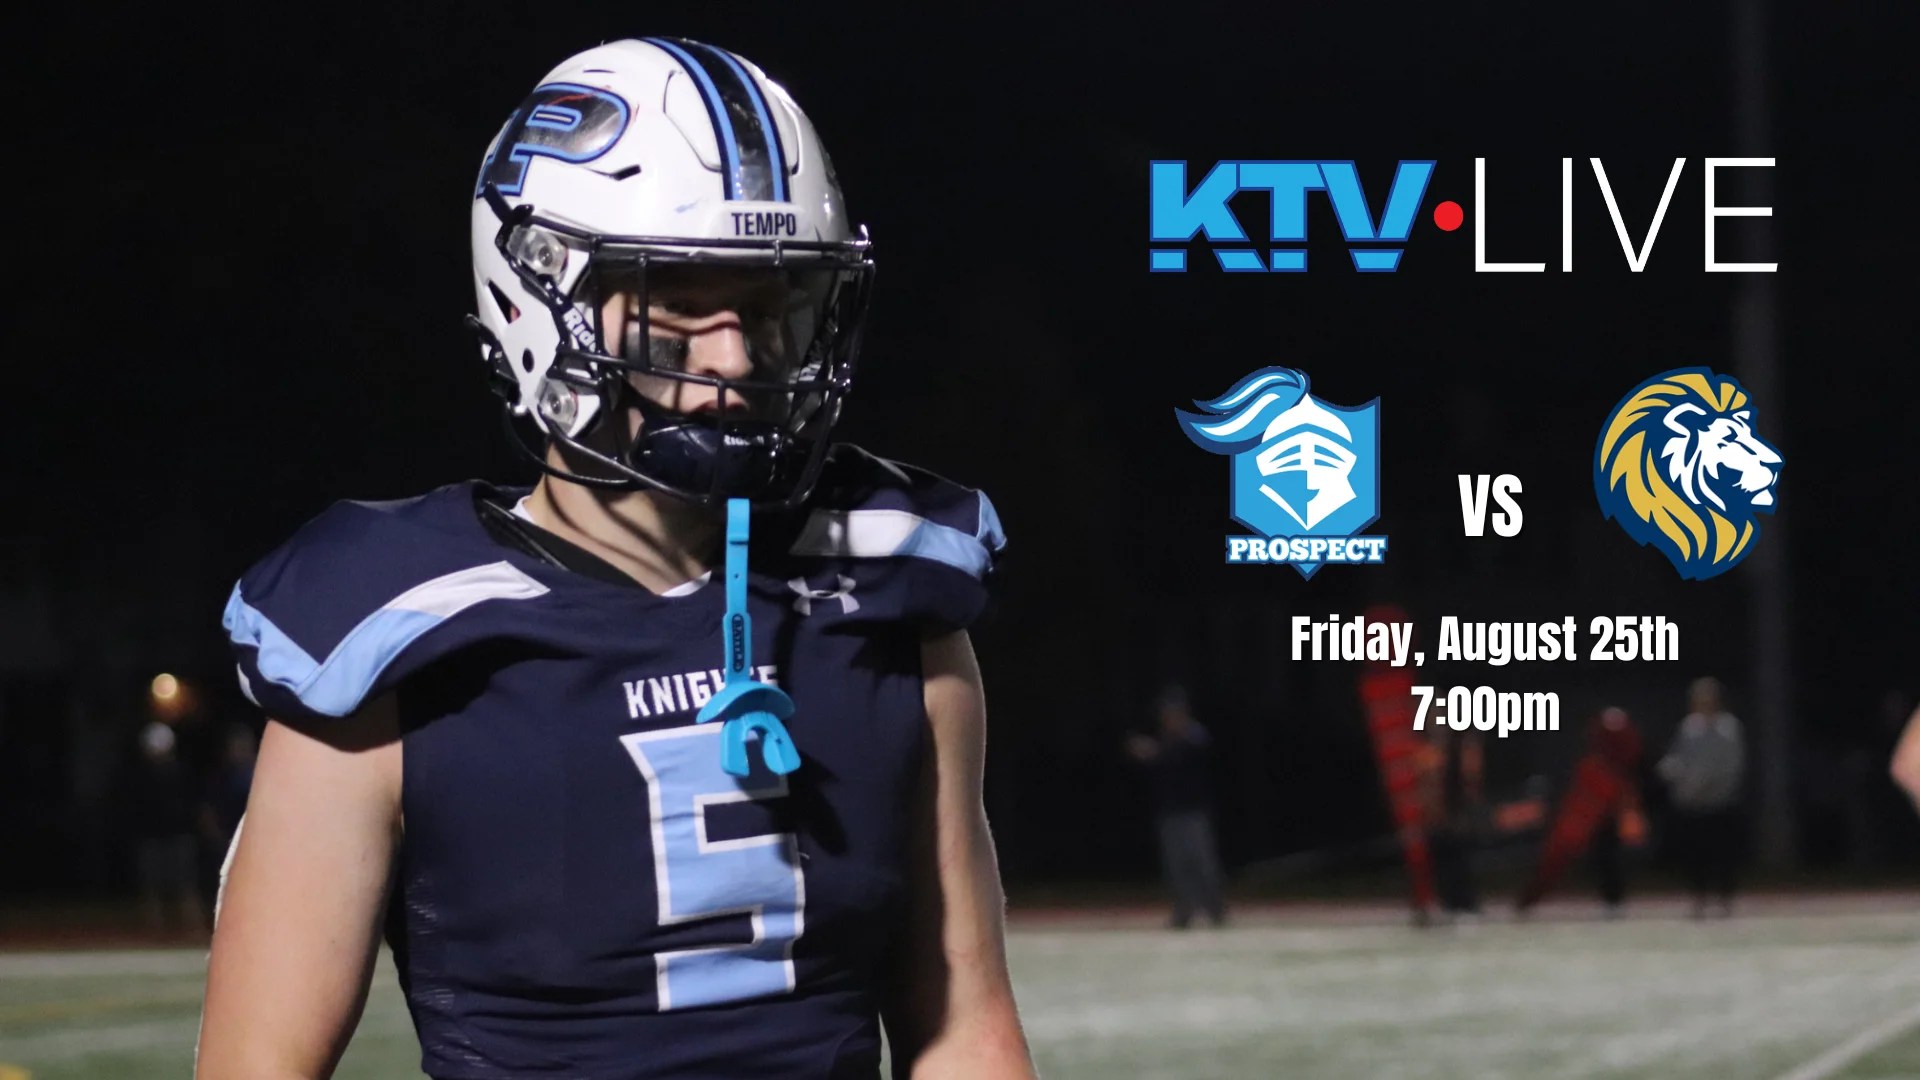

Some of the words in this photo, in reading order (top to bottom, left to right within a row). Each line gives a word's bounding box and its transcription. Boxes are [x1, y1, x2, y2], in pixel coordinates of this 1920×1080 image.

[731, 212, 797, 236] TEMPO
[622, 664, 779, 719] KNIGS
[619, 723, 805, 1012] 5
